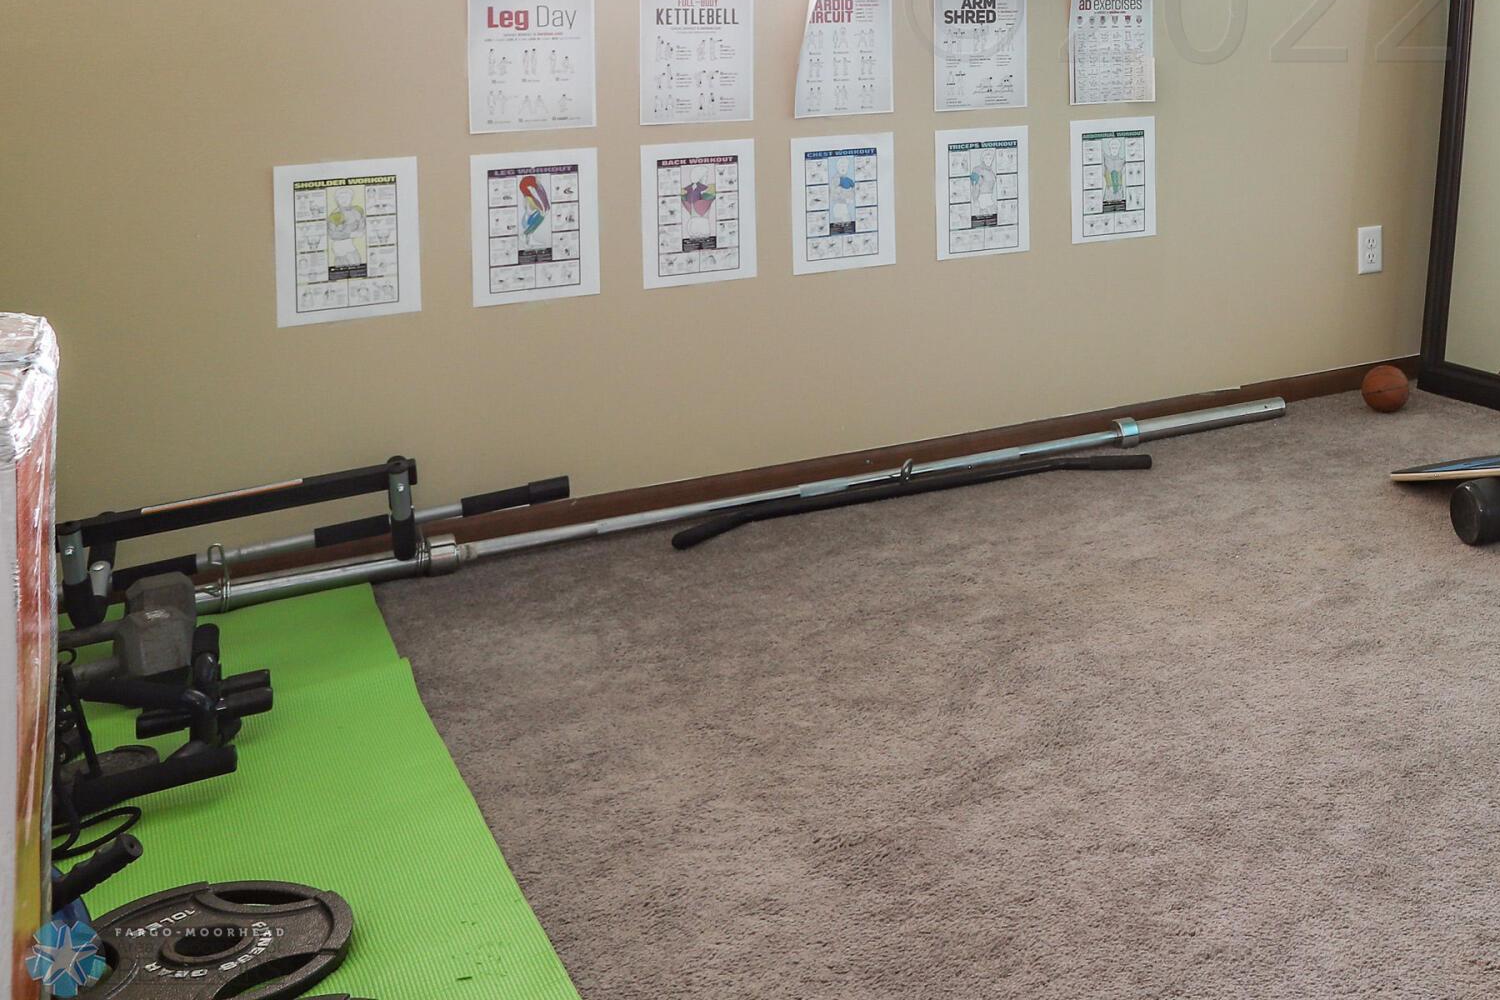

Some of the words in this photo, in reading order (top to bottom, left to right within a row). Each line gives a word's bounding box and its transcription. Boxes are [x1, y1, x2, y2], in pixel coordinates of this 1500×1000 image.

[487, 6, 529, 31] Leg
[536, 5, 577, 30] Day
[656, 8, 739, 25] KETTLEBELL
[808, 11, 854, 24] IRCUIT
[944, 10, 997, 24] SHRED
[834, 148, 875, 156] WORKOUT
[689, 156, 733, 164] WORKOUT
[518, 166, 572, 174] WORKOUT
[294, 179, 346, 189] SHOULDER
[348, 176, 395, 185] WORKOUT
